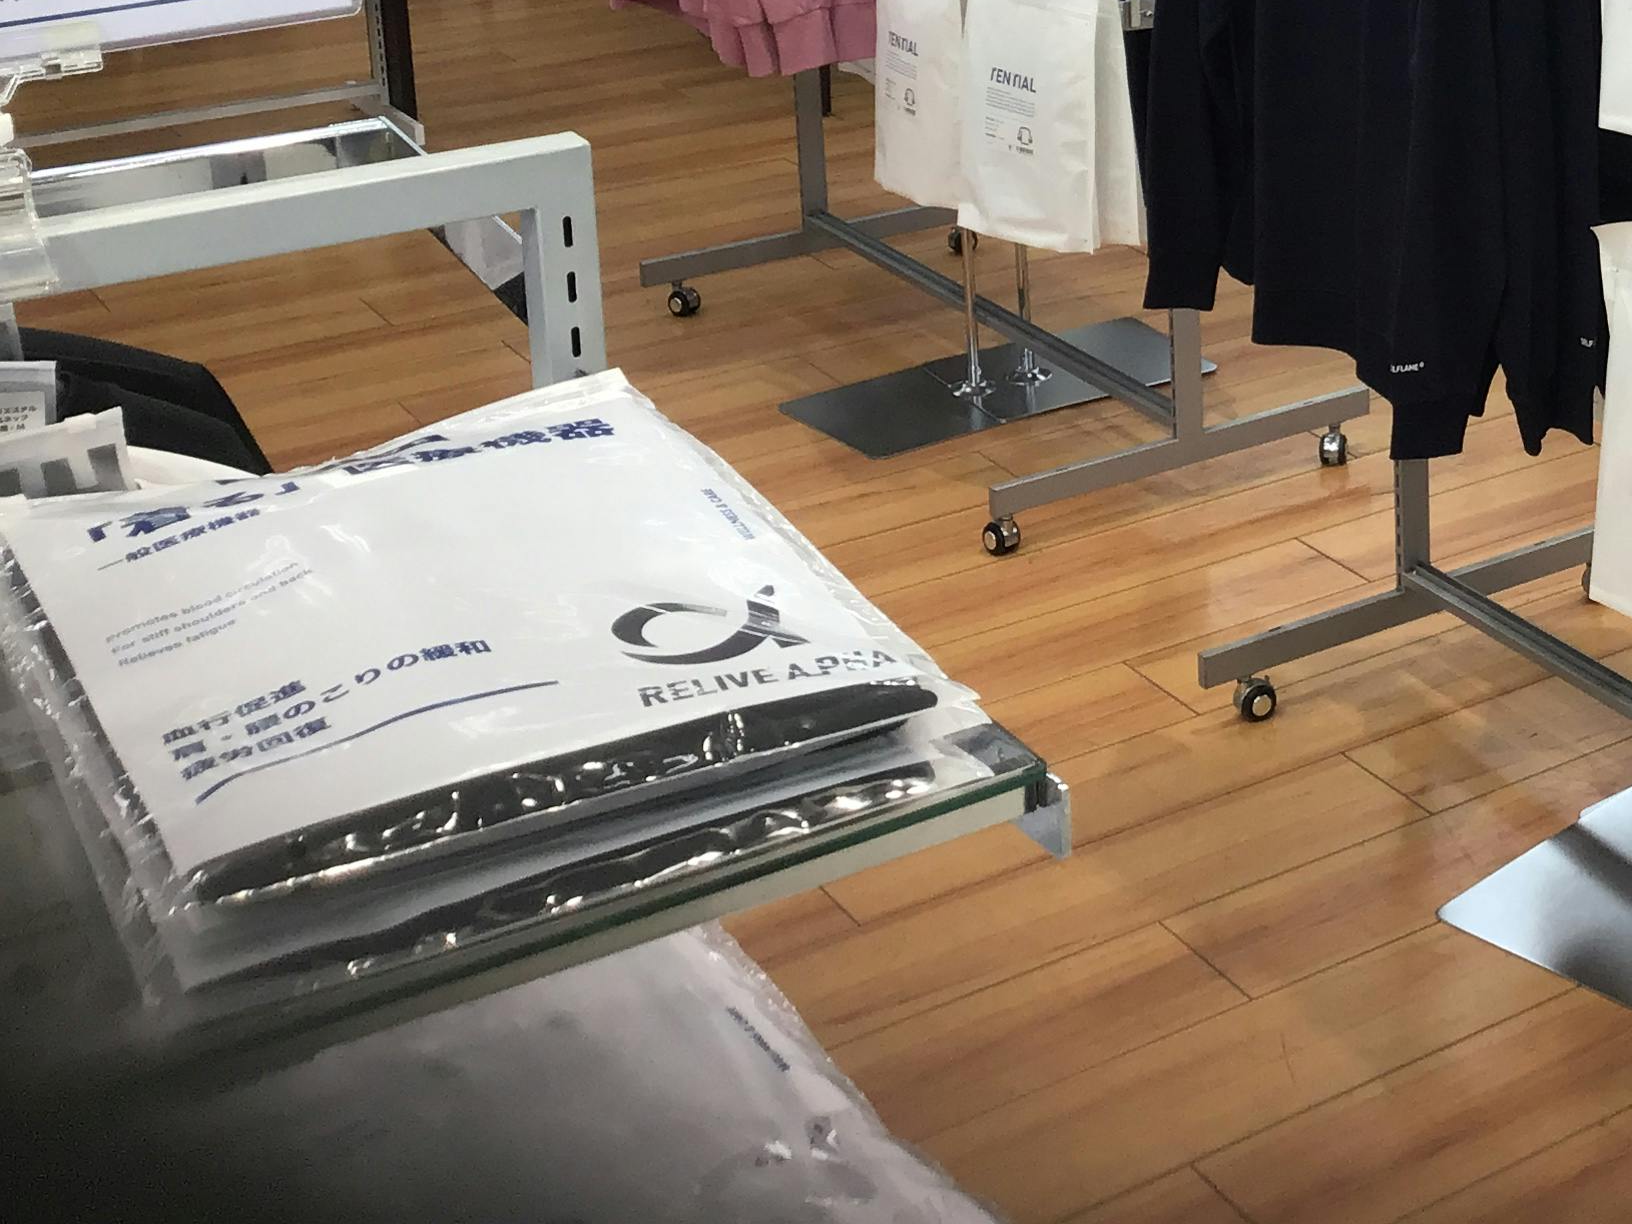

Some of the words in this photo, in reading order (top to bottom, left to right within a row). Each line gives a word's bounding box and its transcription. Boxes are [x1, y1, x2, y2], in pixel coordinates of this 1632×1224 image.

[888, 30, 919, 57] TENTIAL
[990, 66, 1037, 93] TENTIAL
[97, 507, 263, 572] 一般医療機器
[162, 679, 307, 745] 血行促進
[638, 668, 779, 707] RELIVE
[180, 716, 332, 782] 疲労回復
